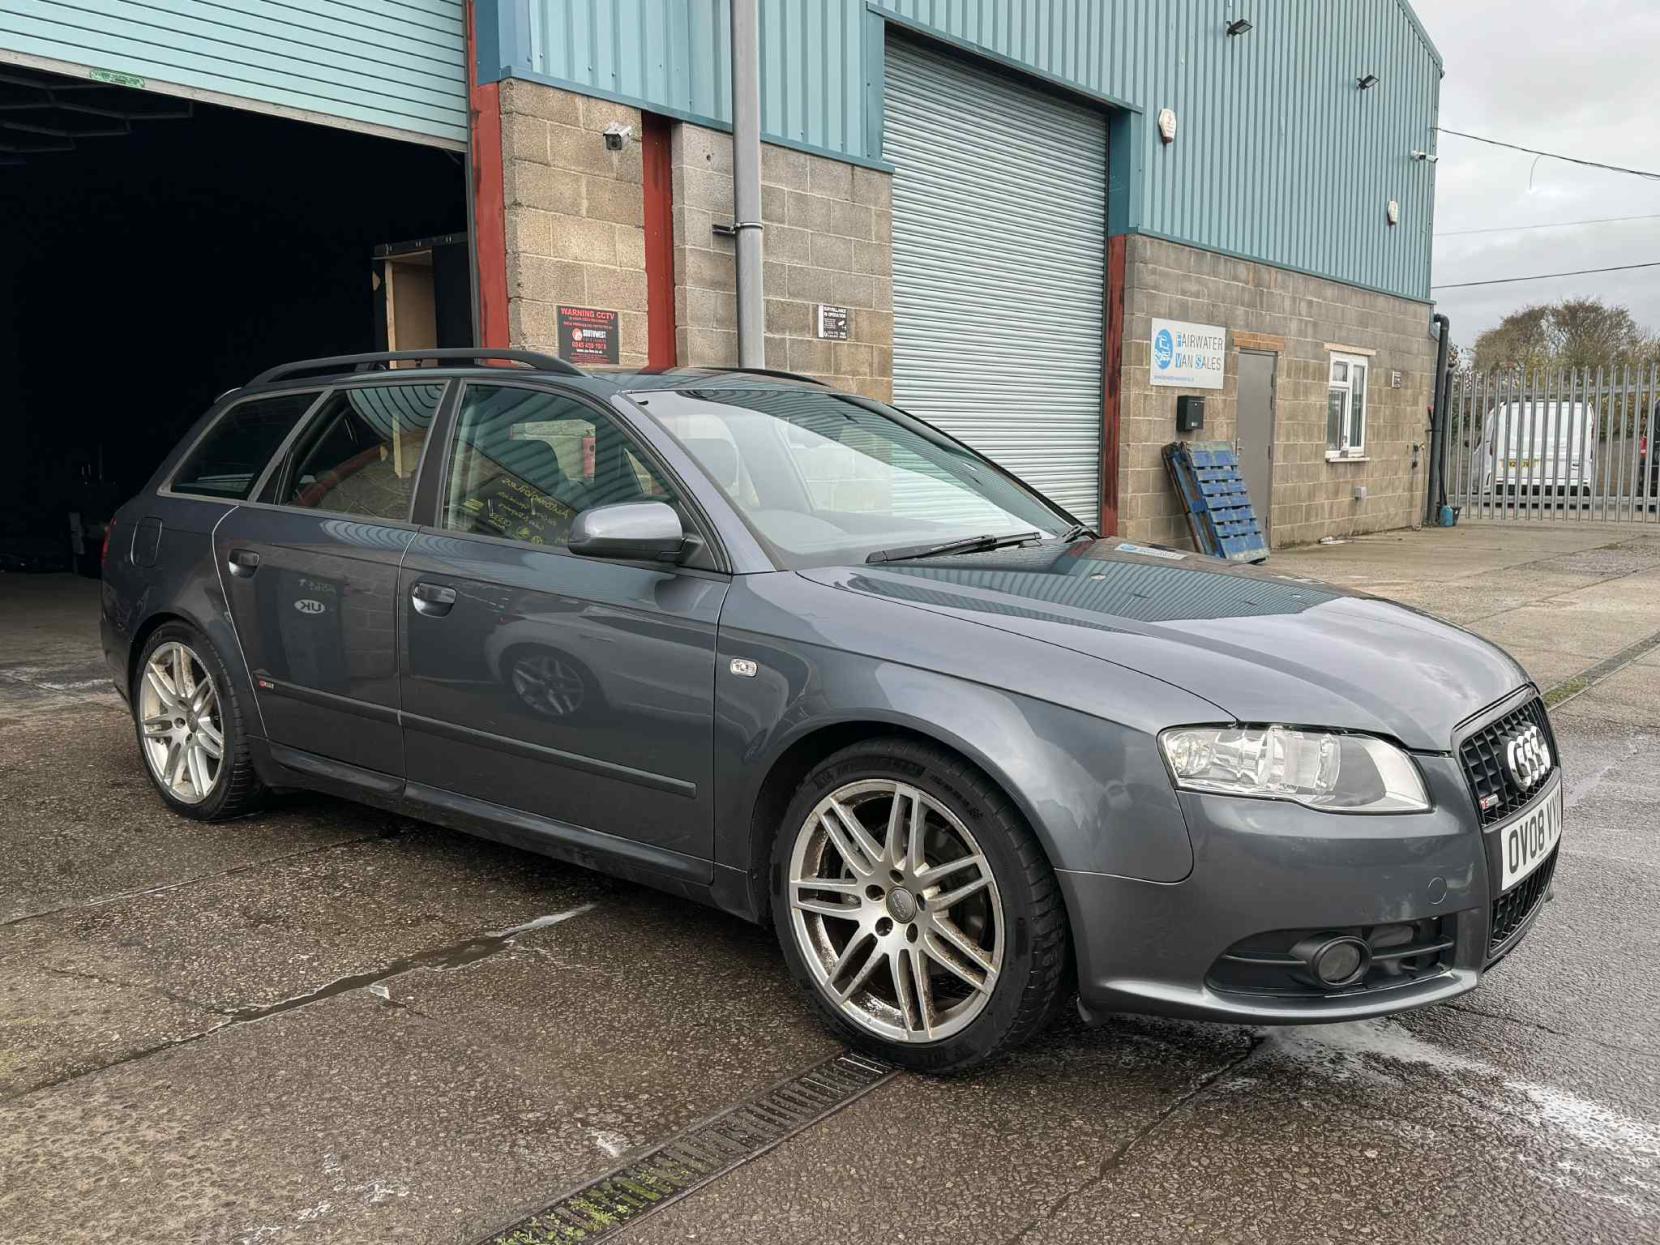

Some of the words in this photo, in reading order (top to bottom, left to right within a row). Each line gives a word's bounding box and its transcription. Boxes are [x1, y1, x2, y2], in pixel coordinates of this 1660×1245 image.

[561, 307, 595, 317] WARNING
[596, 311, 615, 320] CCTV
[1175, 353, 1193, 369] VAN
[1195, 355, 1222, 371] SALES
[1508, 808, 1545, 875] OV08
